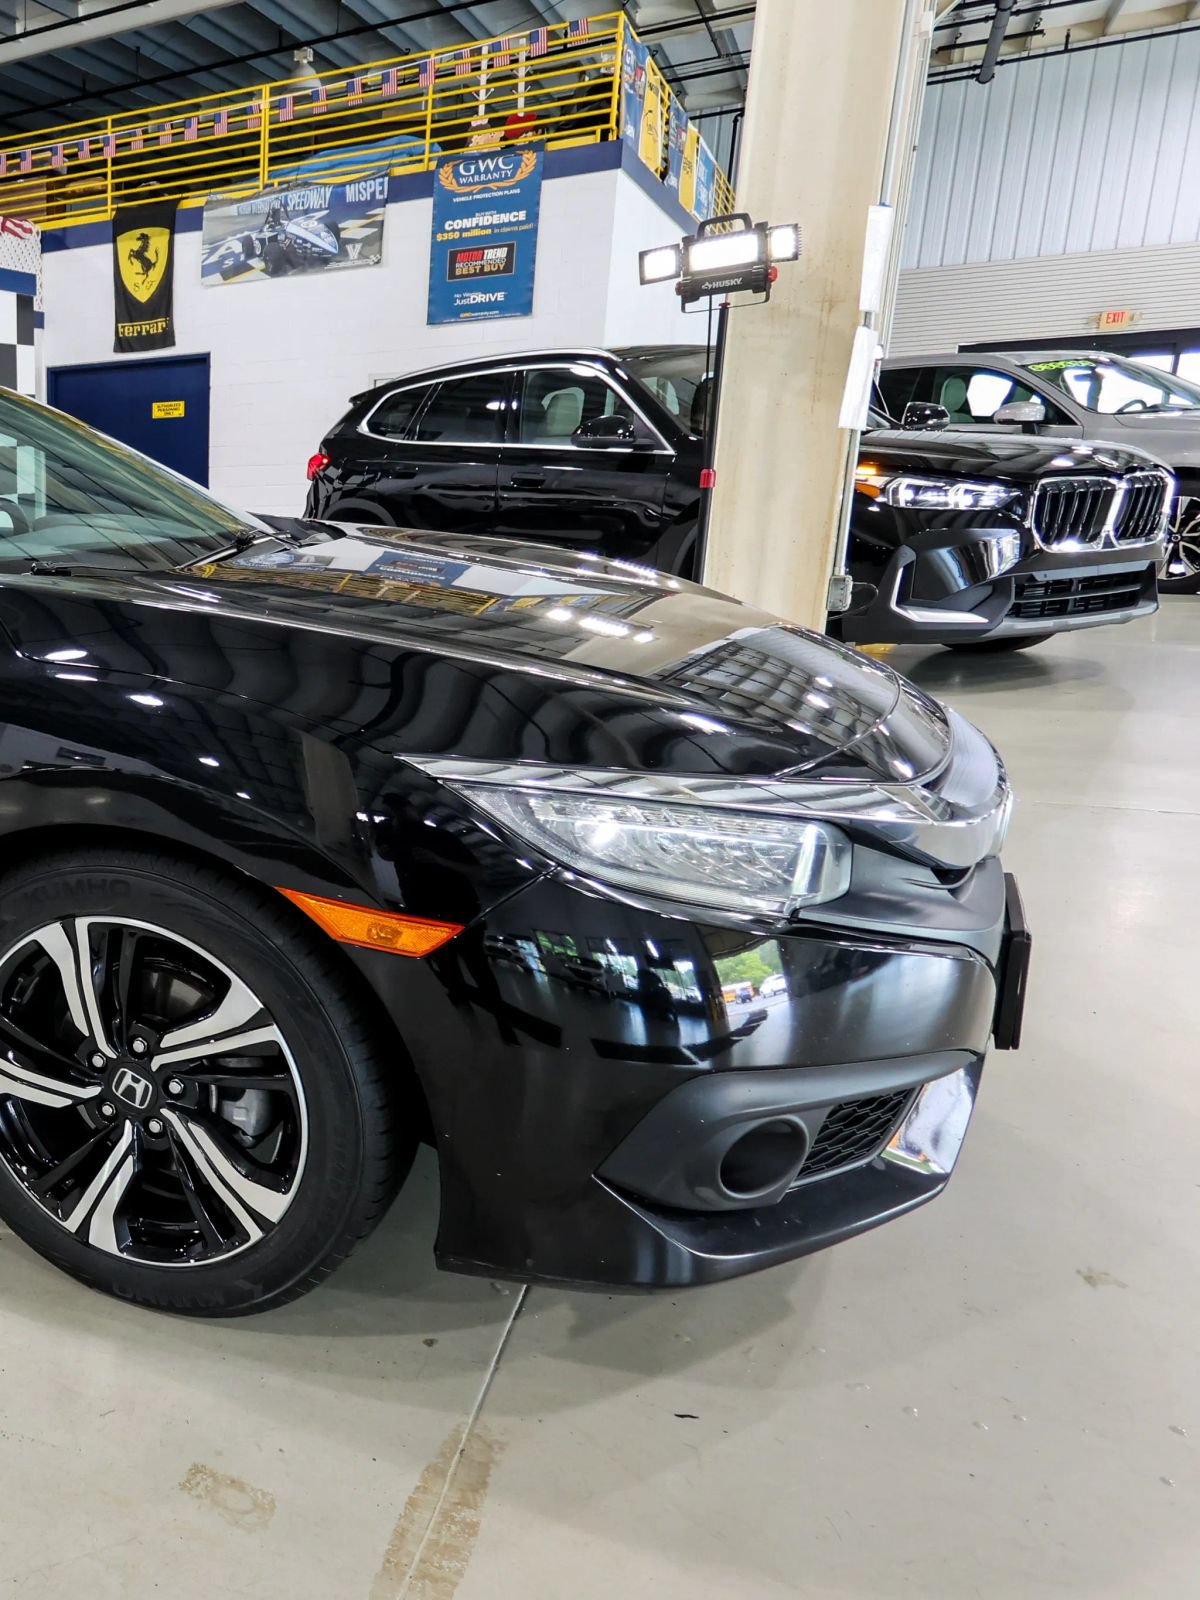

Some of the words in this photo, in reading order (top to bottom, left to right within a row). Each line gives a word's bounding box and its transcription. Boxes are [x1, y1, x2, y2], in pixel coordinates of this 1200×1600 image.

[459, 154, 515, 176] GWC
[459, 169, 513, 185] WARRANTY
[287, 185, 334, 211] SPEEDWAY
[452, 195, 473, 203] VEHICLE
[473, 190, 504, 200] PROTECTION
[444, 210, 527, 231] CONFIDENCE
[436, 231, 460, 241] $350
[462, 228, 492, 238] million
[456, 249, 483, 263] MOTOR
[483, 247, 508, 260] TREND
[455, 257, 507, 268] RECOMMENDED
[455, 265, 481, 275] BEST
[483, 262, 506, 272] BUY
[712, 277, 742, 289] HUSKY
[1105, 311, 1126, 324] EXIT
